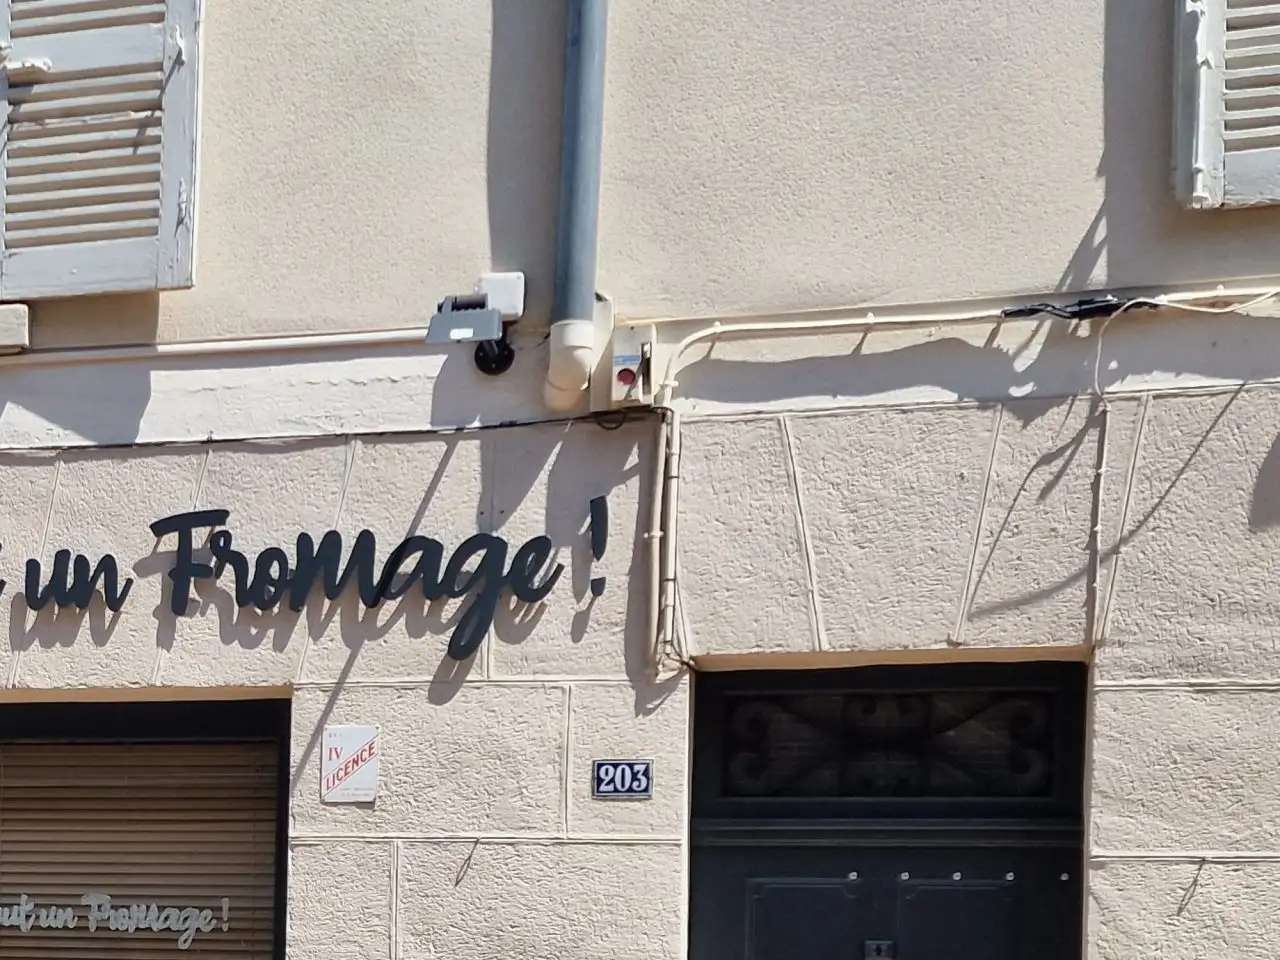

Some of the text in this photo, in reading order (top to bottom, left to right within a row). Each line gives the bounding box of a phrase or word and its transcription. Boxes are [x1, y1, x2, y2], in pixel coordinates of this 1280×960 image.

[25, 548, 134, 612] un
[150, 509, 565, 661] Fromage
[326, 741, 376, 790] LICENCE
[328, 746, 343, 761] IV
[598, 764, 648, 792] 203
[39, 905, 78, 929] un
[81, 891, 217, 950] Fromage
